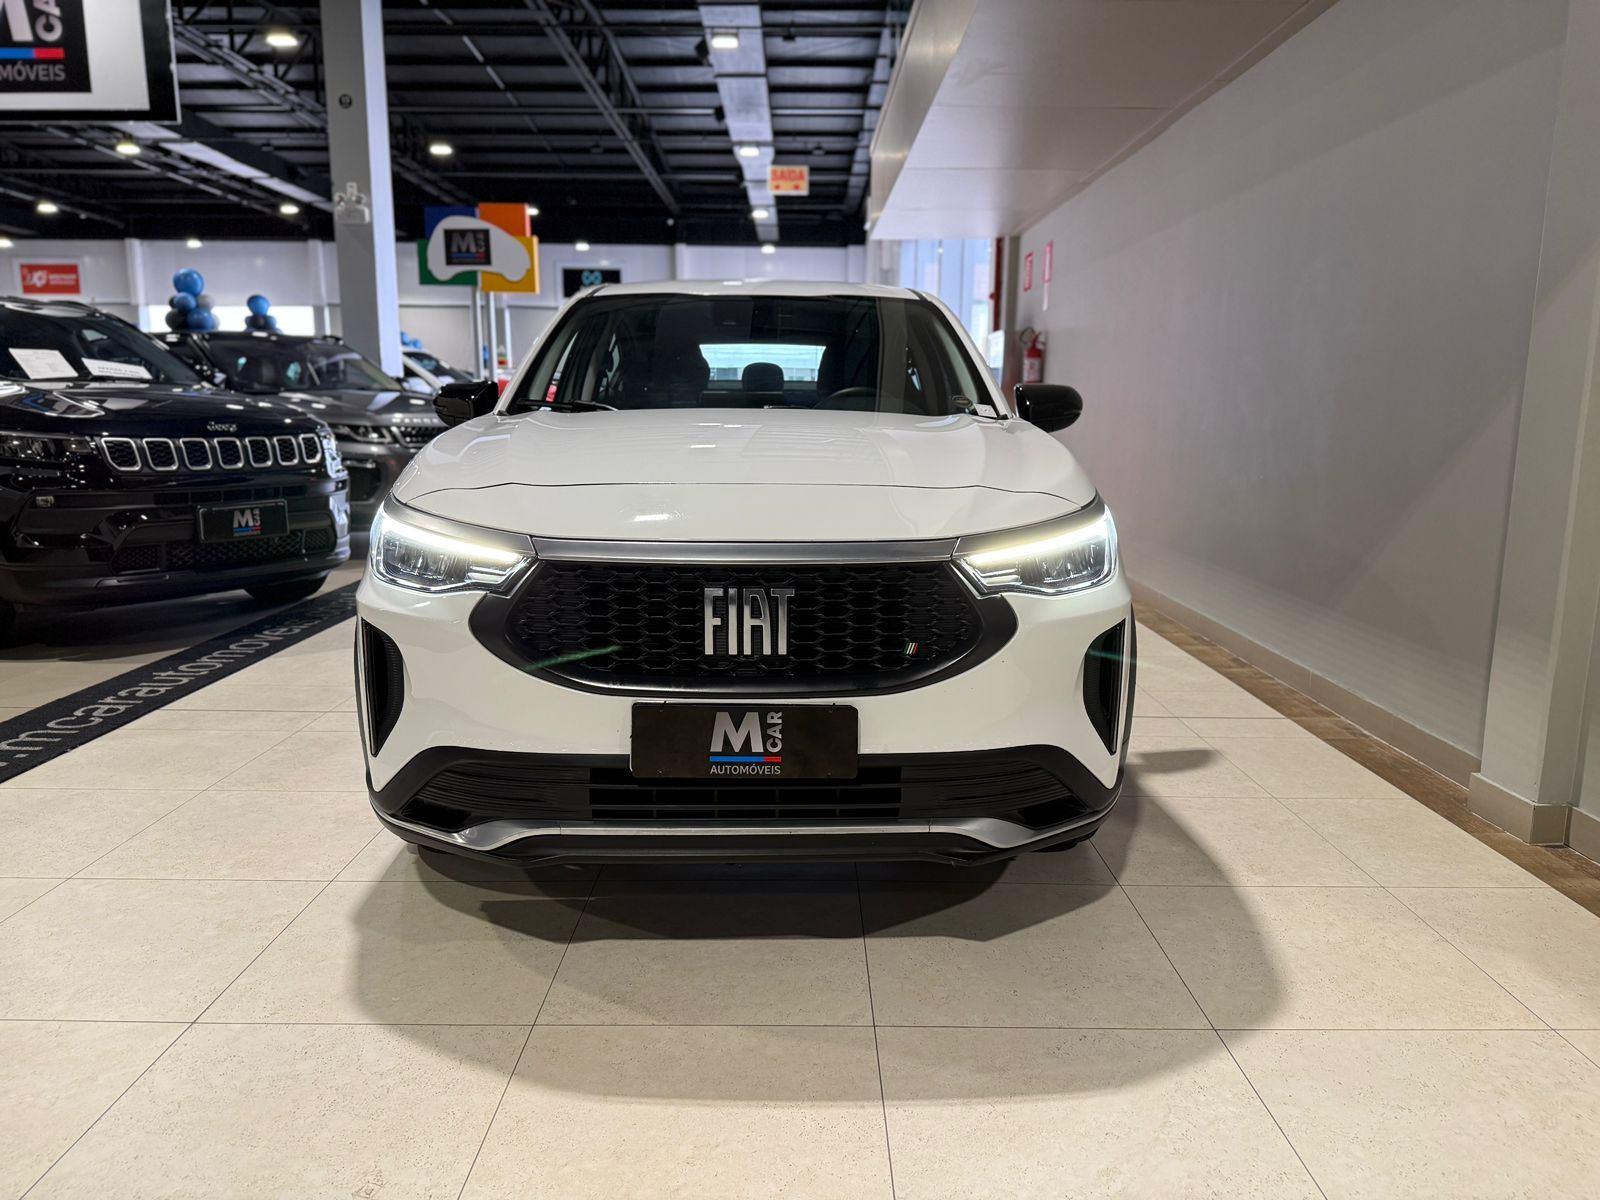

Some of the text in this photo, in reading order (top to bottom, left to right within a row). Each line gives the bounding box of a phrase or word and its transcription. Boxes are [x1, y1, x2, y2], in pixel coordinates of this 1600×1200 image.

[33, 0, 63, 42] CA
[0, 61, 66, 81] MÓVEIS
[233, 509, 254, 528] M
[704, 588, 795, 655] FIAT
[710, 711, 783, 753] M CAR
[710, 763, 781, 775] AUTOMÓVEIS
